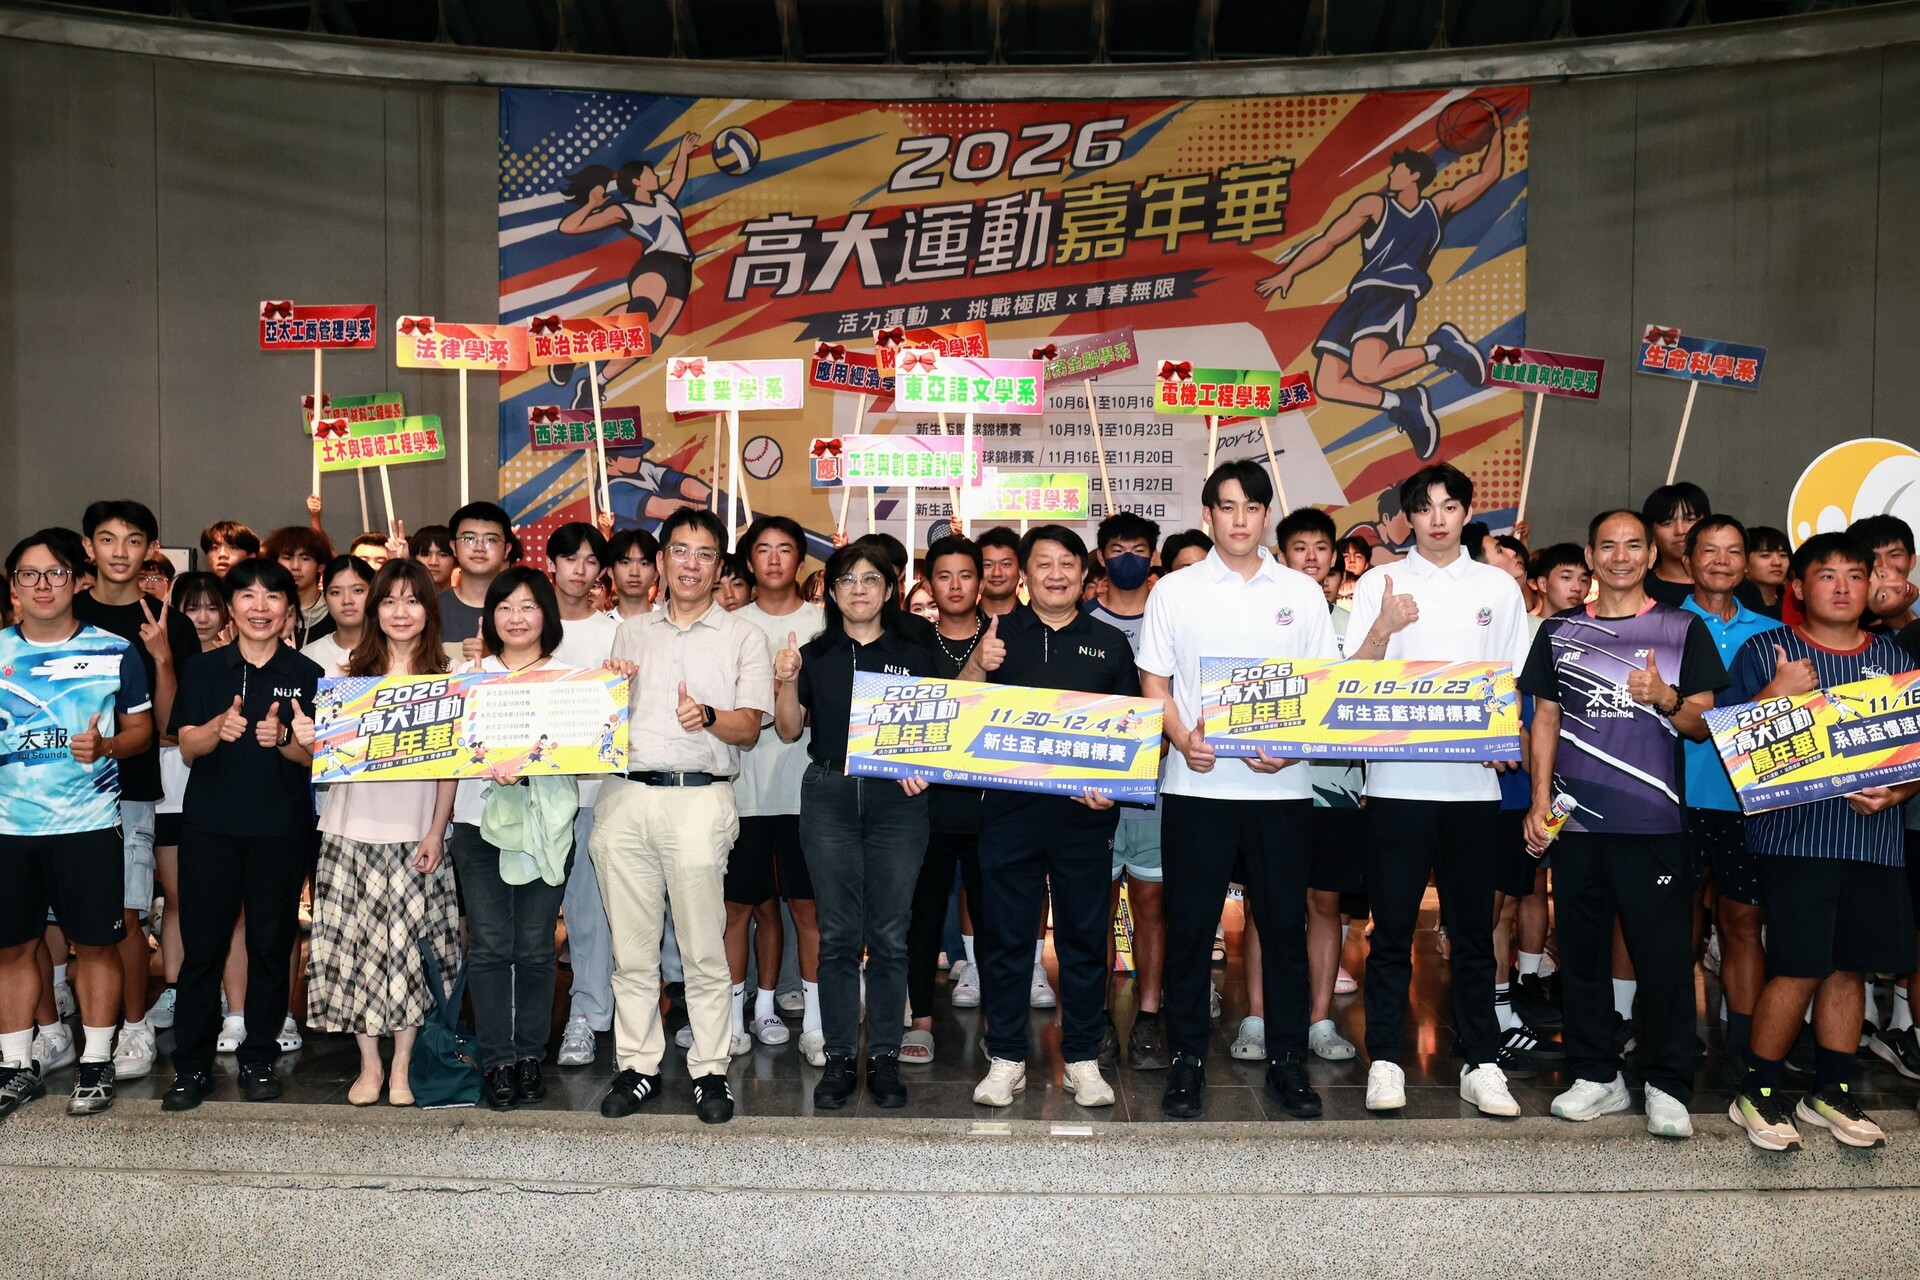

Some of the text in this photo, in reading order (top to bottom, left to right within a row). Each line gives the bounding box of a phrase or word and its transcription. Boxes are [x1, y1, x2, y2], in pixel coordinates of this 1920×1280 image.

[889, 118, 1126, 191] 2026
[727, 160, 1293, 299] 高大運動嘉年華
[837, 307, 929, 334] 活力運動
[967, 292, 1057, 320] 挑戰極限
[1085, 278, 1176, 308] 青春無限
[264, 317, 373, 344] 亞太工商管理學系
[535, 325, 645, 357] 政治法律學系
[415, 337, 512, 363] 法律學系
[880, 335, 984, 369] 財律學系
[1642, 344, 1760, 383] 生命科學系
[685, 376, 786, 403] 建築學系
[903, 375, 1038, 405] 東亞語文學系
[1161, 381, 1272, 410] 電機工程學系
[307, 402, 402, 427] 化工程及材料工程學系
[322, 428, 439, 463] 土木與環境工程學系
[534, 418, 637, 446] 西洋語文學系
[816, 457, 843, 482] 應
[1049, 450, 1173, 464] 11月16日至11月20日
[1088, 478, 1173, 491] 日至11月27日
[1232, 662, 1293, 683] 2026
[1336, 678, 1472, 695] 10/19-10/23
[373, 680, 449, 708] 2026
[884, 683, 947, 702] 2026
[1220, 676, 1307, 705] 高大運動
[358, 696, 463, 735] 高大運動
[869, 698, 959, 724] 高大運動
[990, 707, 1112, 733] 11/30-12/4
[1229, 700, 1302, 726] 嘉年華
[1337, 703, 1482, 723] 新生盃籃球錦標賽
[1586, 710, 1599, 718] Tai
[1737, 696, 1793, 729] 2026
[17, 728, 68, 751] 太報
[368, 724, 454, 760] 嘉年華
[876, 721, 950, 746] 嘉年華
[1735, 706, 1815, 753] 高大運動
[1832, 714, 1920, 749] 系際盃慢速
[31, 751, 68, 760] Sounds
[983, 730, 1126, 763] 新生盃桌球錦標賽
[1750, 730, 1818, 775] 嘉年華
